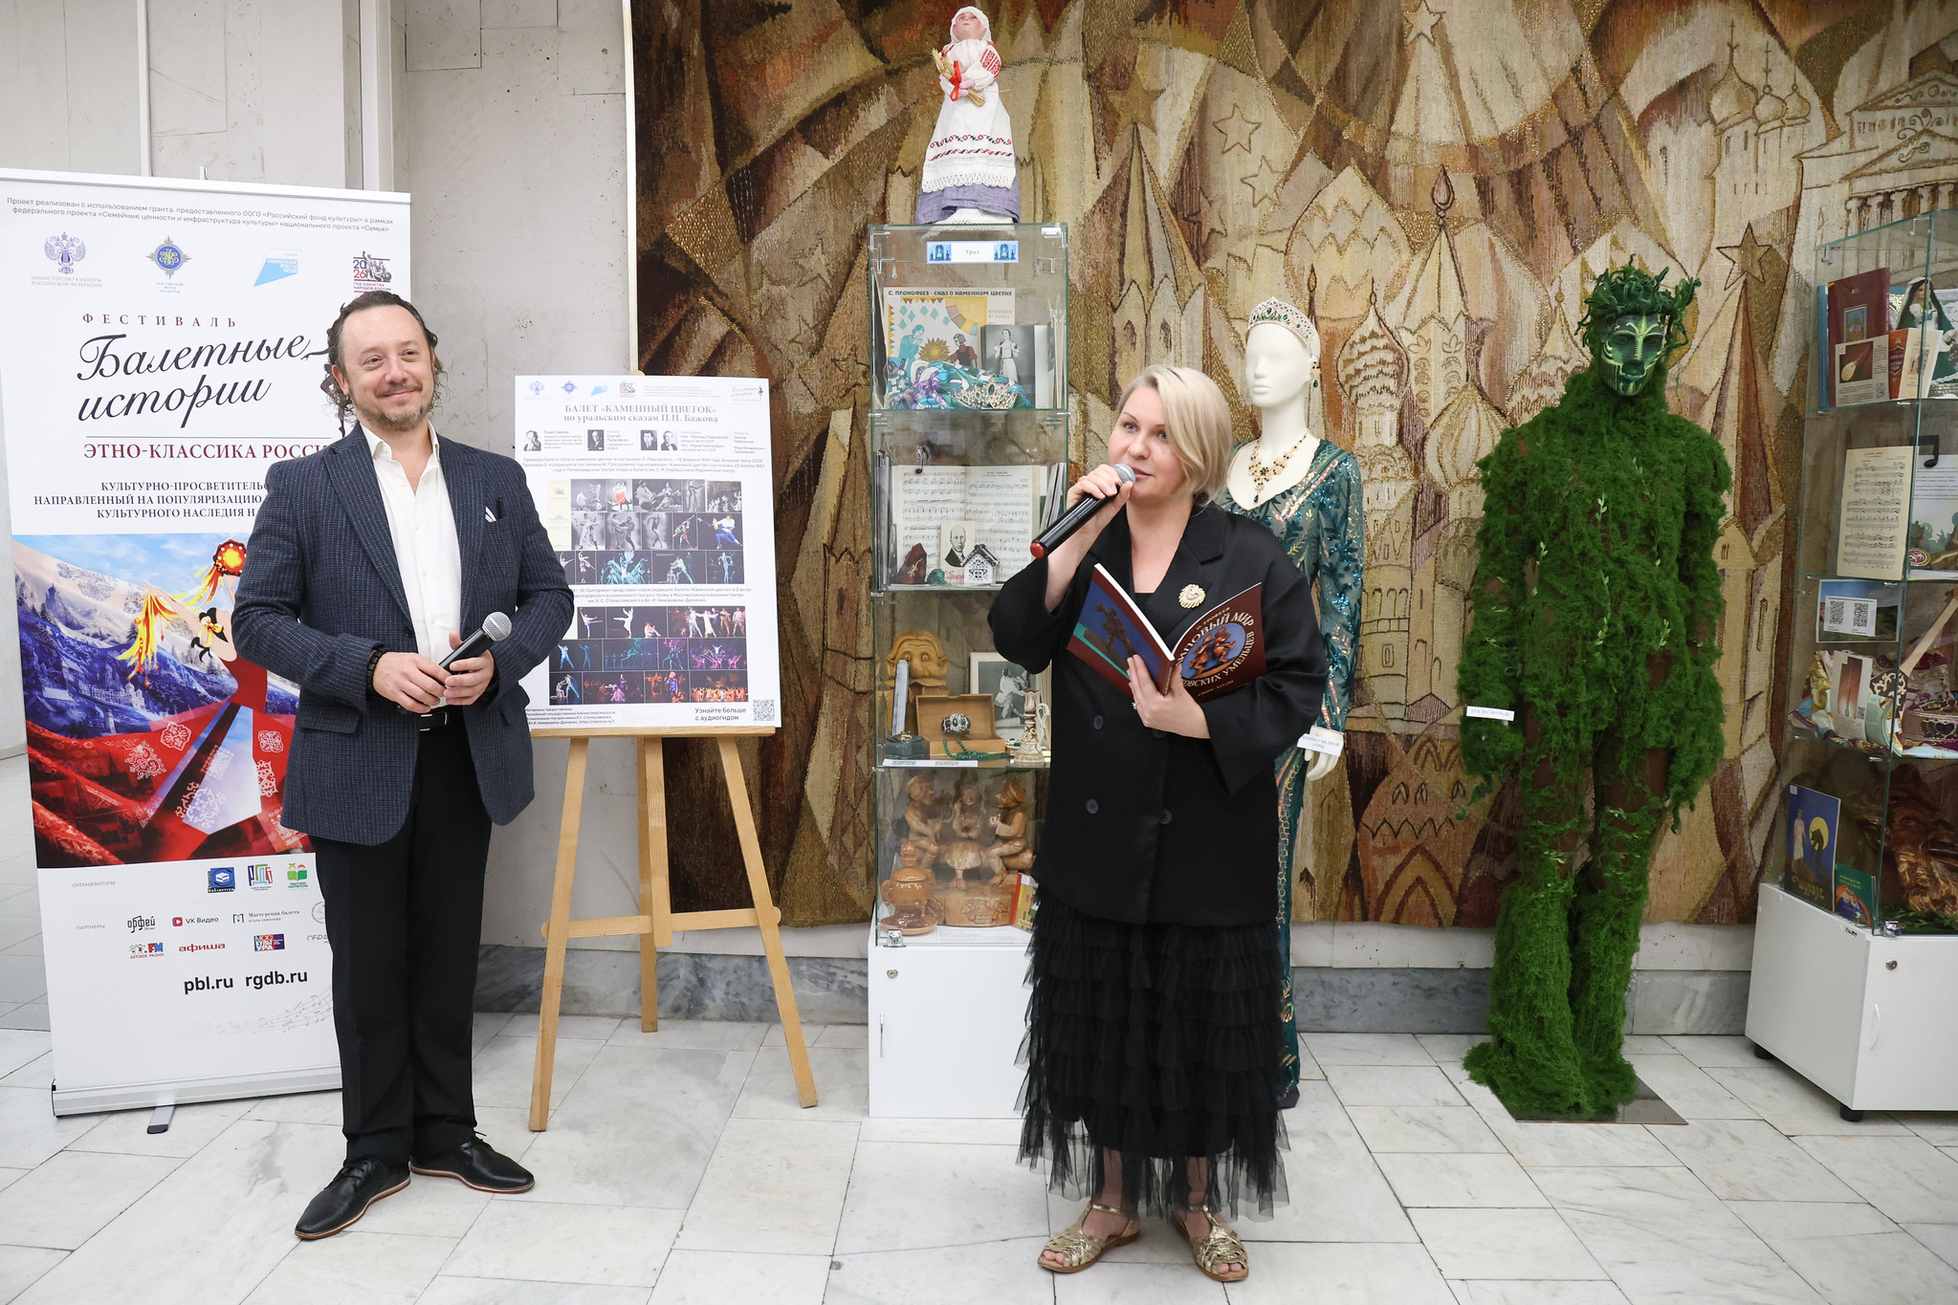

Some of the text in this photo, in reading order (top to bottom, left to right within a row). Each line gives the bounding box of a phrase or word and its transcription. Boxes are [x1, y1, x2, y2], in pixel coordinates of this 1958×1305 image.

[82, 313, 236, 328] ФЕСТИВАЛЬ
[77, 333, 328, 381] Балетные
[78, 374, 272, 428] истории
[564, 404, 599, 413] БАЛЕТ
[577, 415, 626, 424] уральским
[684, 414, 719, 423] Бажова
[83, 443, 327, 459] ЭТНО-КЛАССИКА РОСС
[33, 494, 263, 506] НАПРАВЛЕННЫЙ НА ПОПУЛЯРИЗАЦИЮ
[97, 508, 181, 519] КУЛЬТУРНОГО
[183, 507, 245, 519] НАСЛЕДИЯ
[1232, 611, 1255, 626] МИР
[127, 915, 157, 934] орфей
[185, 915, 220, 925] VK Видео
[177, 942, 226, 954] афиша
[183, 969, 308, 995] pbl.ru rgdb.ru
